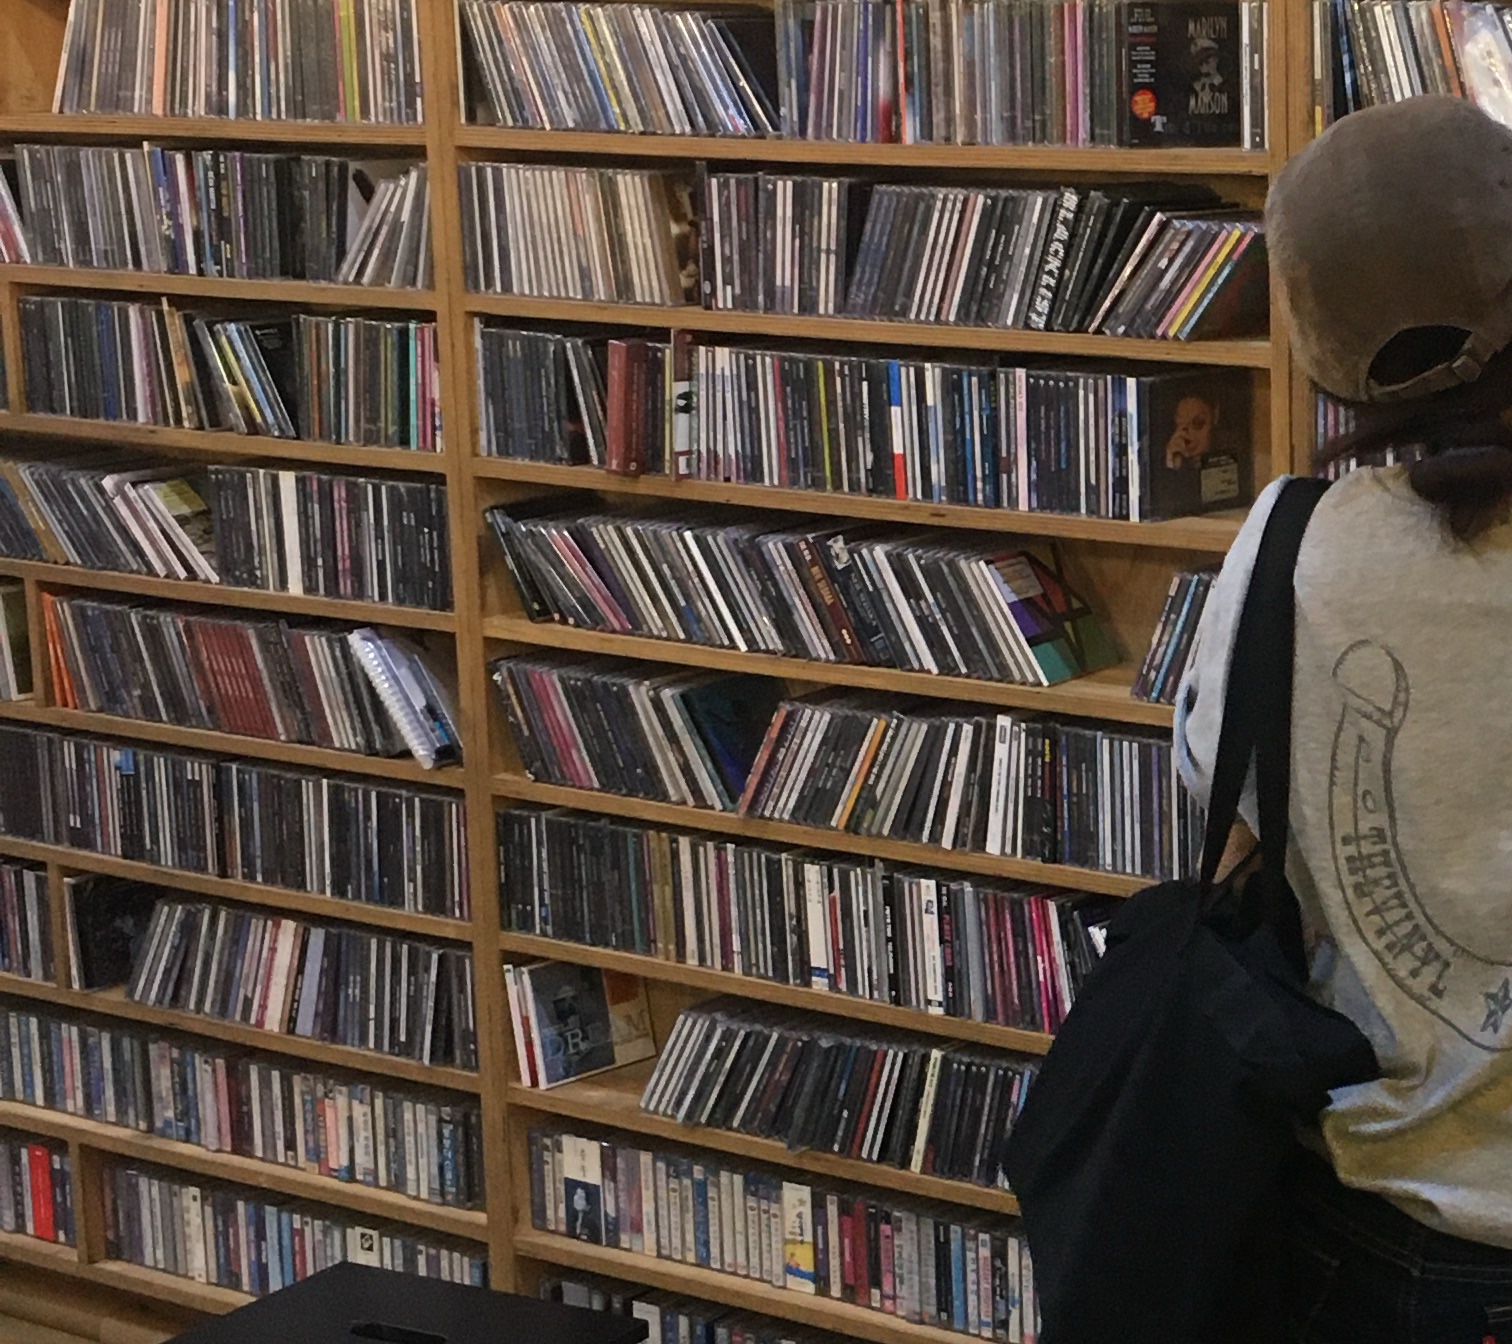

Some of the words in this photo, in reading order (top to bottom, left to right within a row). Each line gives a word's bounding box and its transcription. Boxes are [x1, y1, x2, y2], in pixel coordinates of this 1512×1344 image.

[1187, 16, 1228, 38] MARILYN
[1188, 92, 1229, 115] MANSON
[1034, 187, 1078, 330] BLACKLIST
